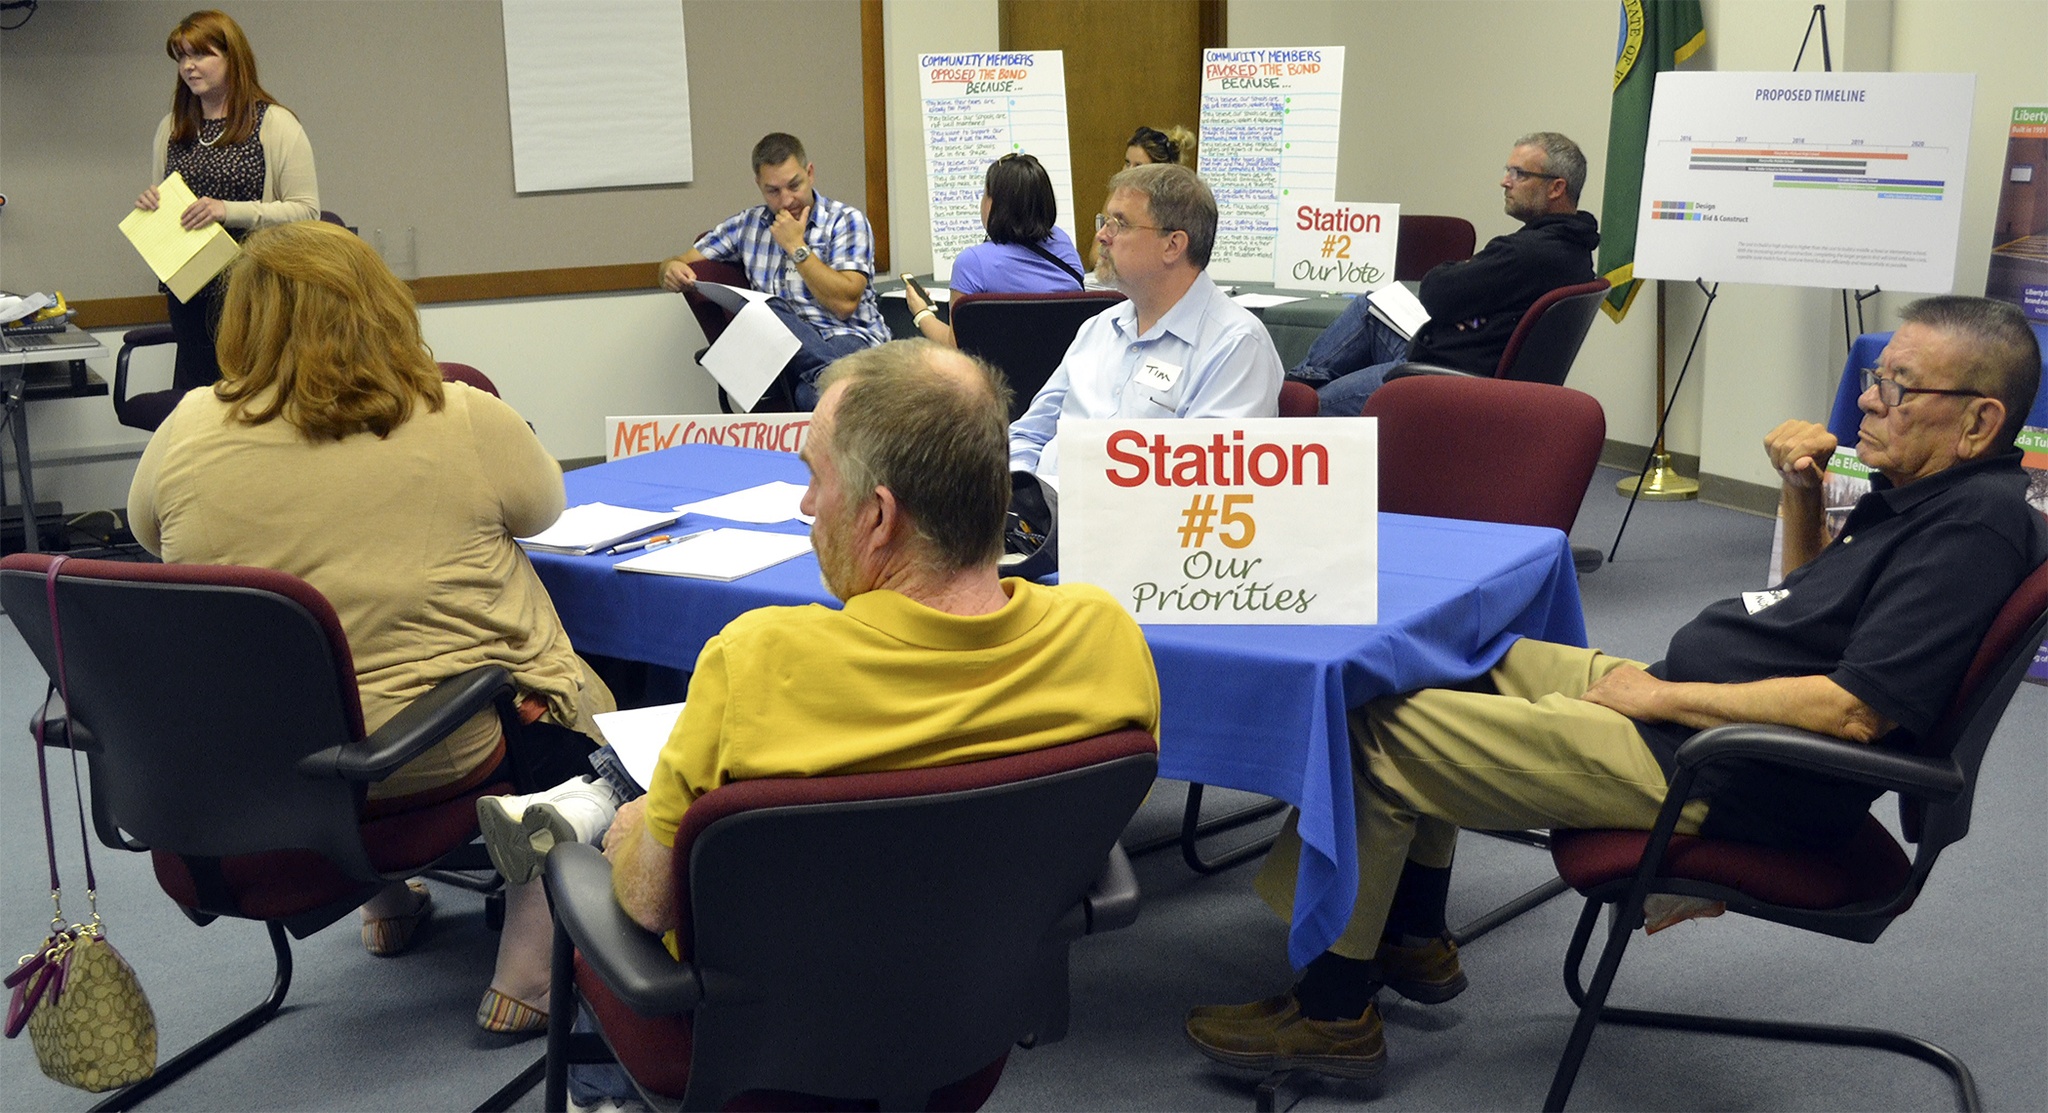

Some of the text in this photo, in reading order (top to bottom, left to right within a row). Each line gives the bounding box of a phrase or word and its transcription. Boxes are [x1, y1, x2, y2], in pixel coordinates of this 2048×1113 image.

[1623, 0, 1640, 65] TATE OF
[922, 54, 1034, 67] COMMUNITY MEMBERS
[1206, 50, 1321, 63] COMMUNITY MEMBERS
[931, 68, 1027, 80] OPPOSED THE BOND
[1206, 64, 1321, 78] FAVORED THE BOND
[1755, 89, 1866, 102] PROPOSED TIMELINE
[2014, 109, 2048, 124] Liberty
[1296, 206, 1381, 233] Station
[1321, 234, 1352, 259] #2
[1292, 260, 1385, 284] Our Vote
[1146, 364, 1170, 382] TIM
[613, 421, 811, 458] NEW CONSTRUCT
[1105, 430, 1329, 488] Station
[1176, 494, 1256, 550] #5
[1183, 551, 1262, 580] Our
[1132, 582, 1317, 614] Priorities
